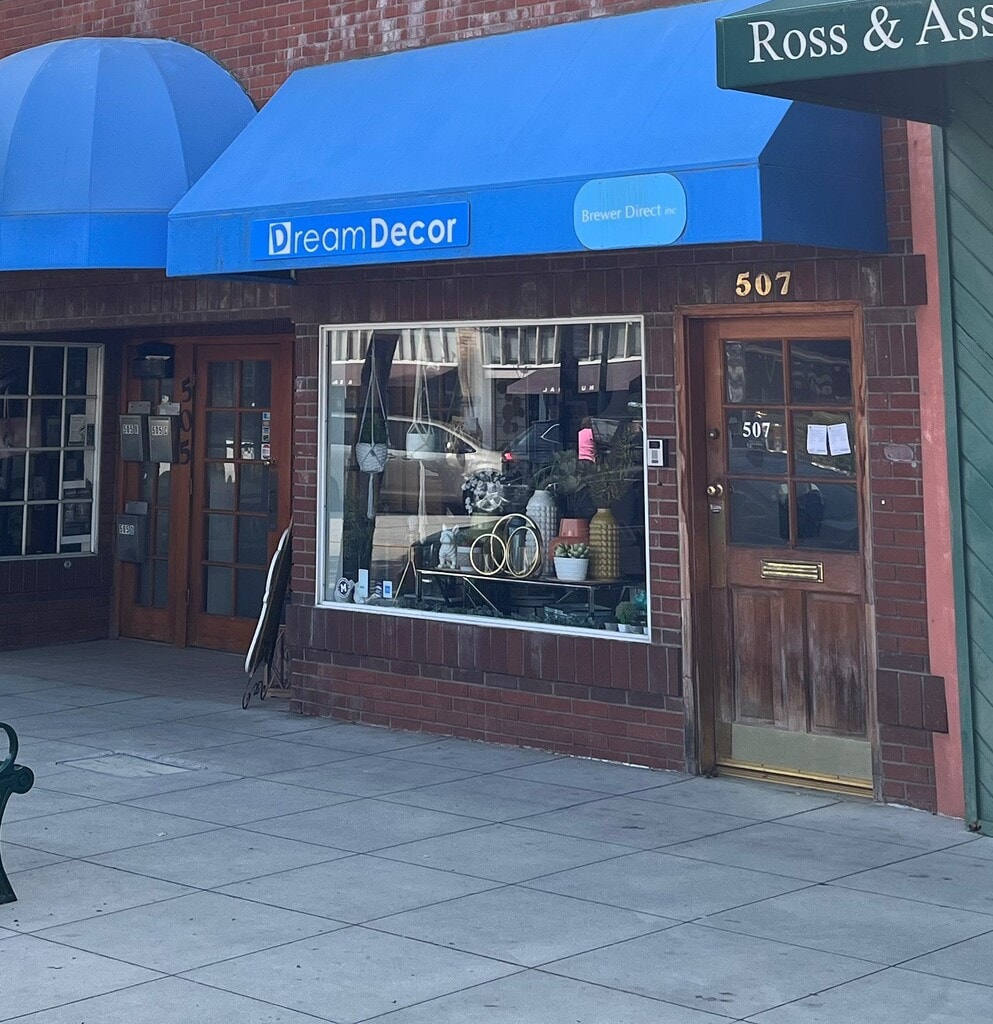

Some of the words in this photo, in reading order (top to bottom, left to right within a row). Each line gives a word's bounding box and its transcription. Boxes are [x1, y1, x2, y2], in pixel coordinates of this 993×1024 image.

[863, 5, 904, 52] &
[581, 208, 621, 224] Brewer
[625, 204, 662, 220] Direct
[735, 271, 791, 297] 507
[742, 421, 771, 438] 507
